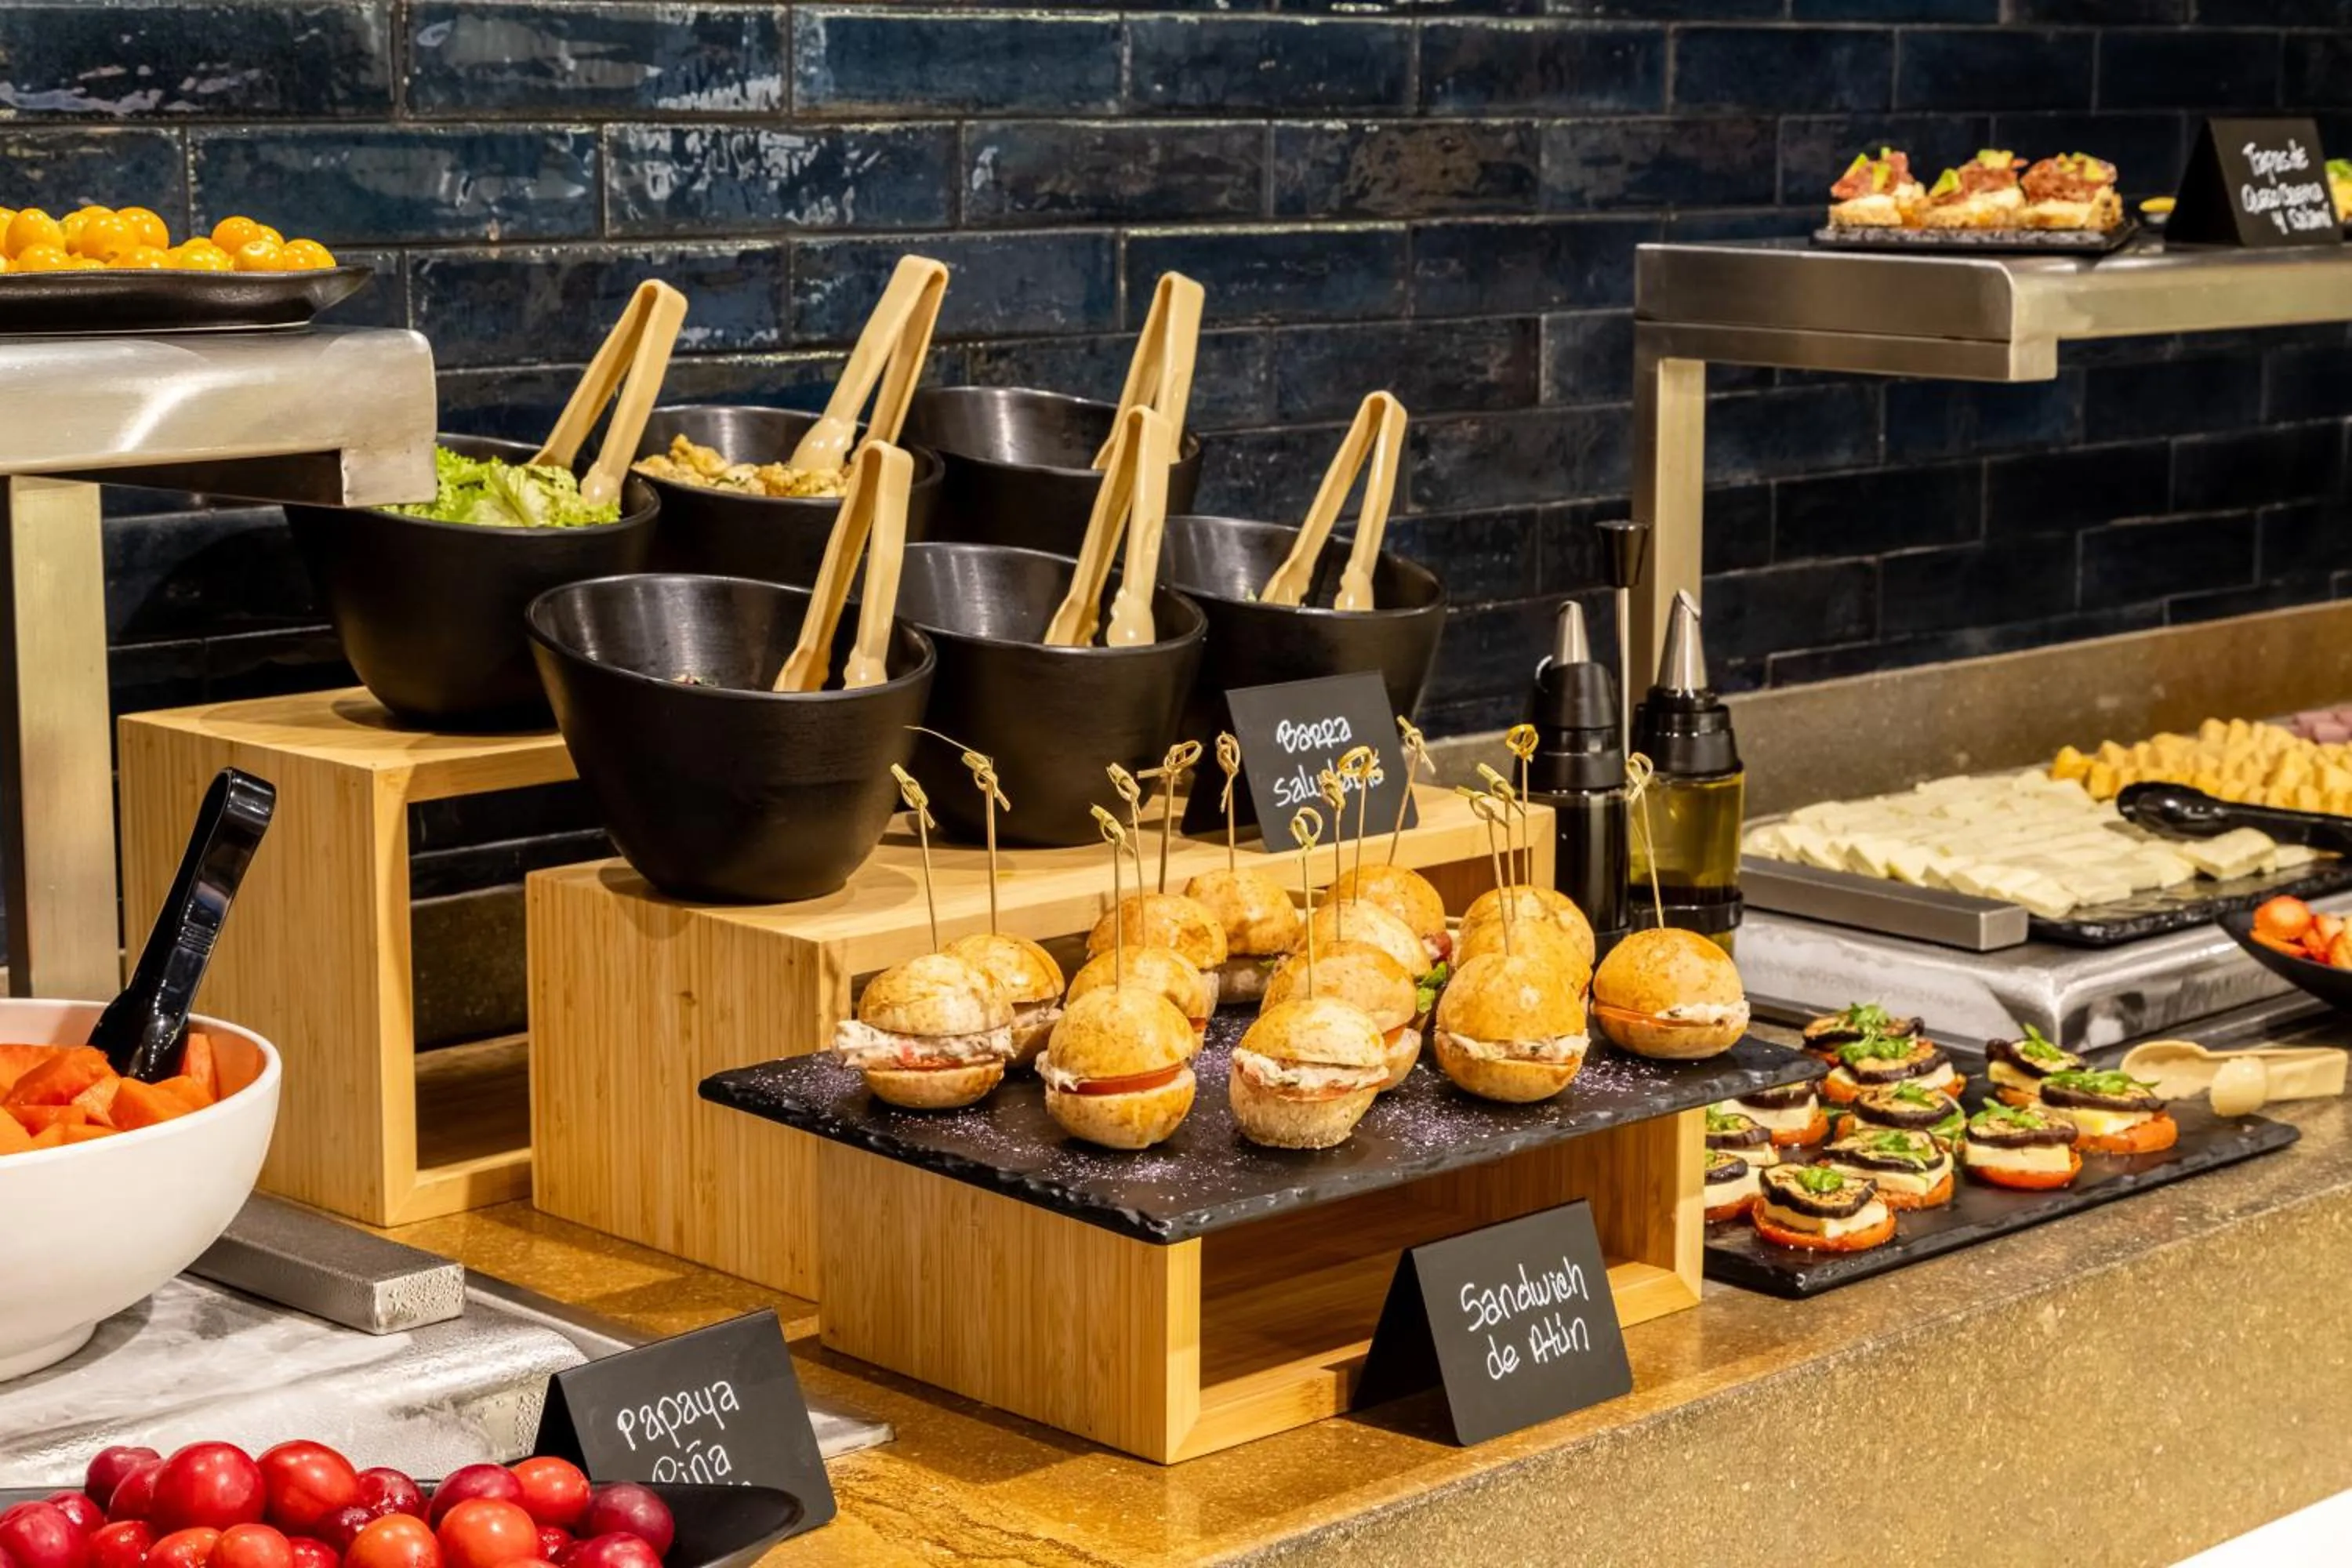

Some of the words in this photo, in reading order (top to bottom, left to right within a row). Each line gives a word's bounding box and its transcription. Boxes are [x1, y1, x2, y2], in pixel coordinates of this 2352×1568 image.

[1461, 1256, 1589, 1331] Sandwich
[1486, 1334, 1520, 1381] de
[616, 1381, 740, 1451] Papaya
